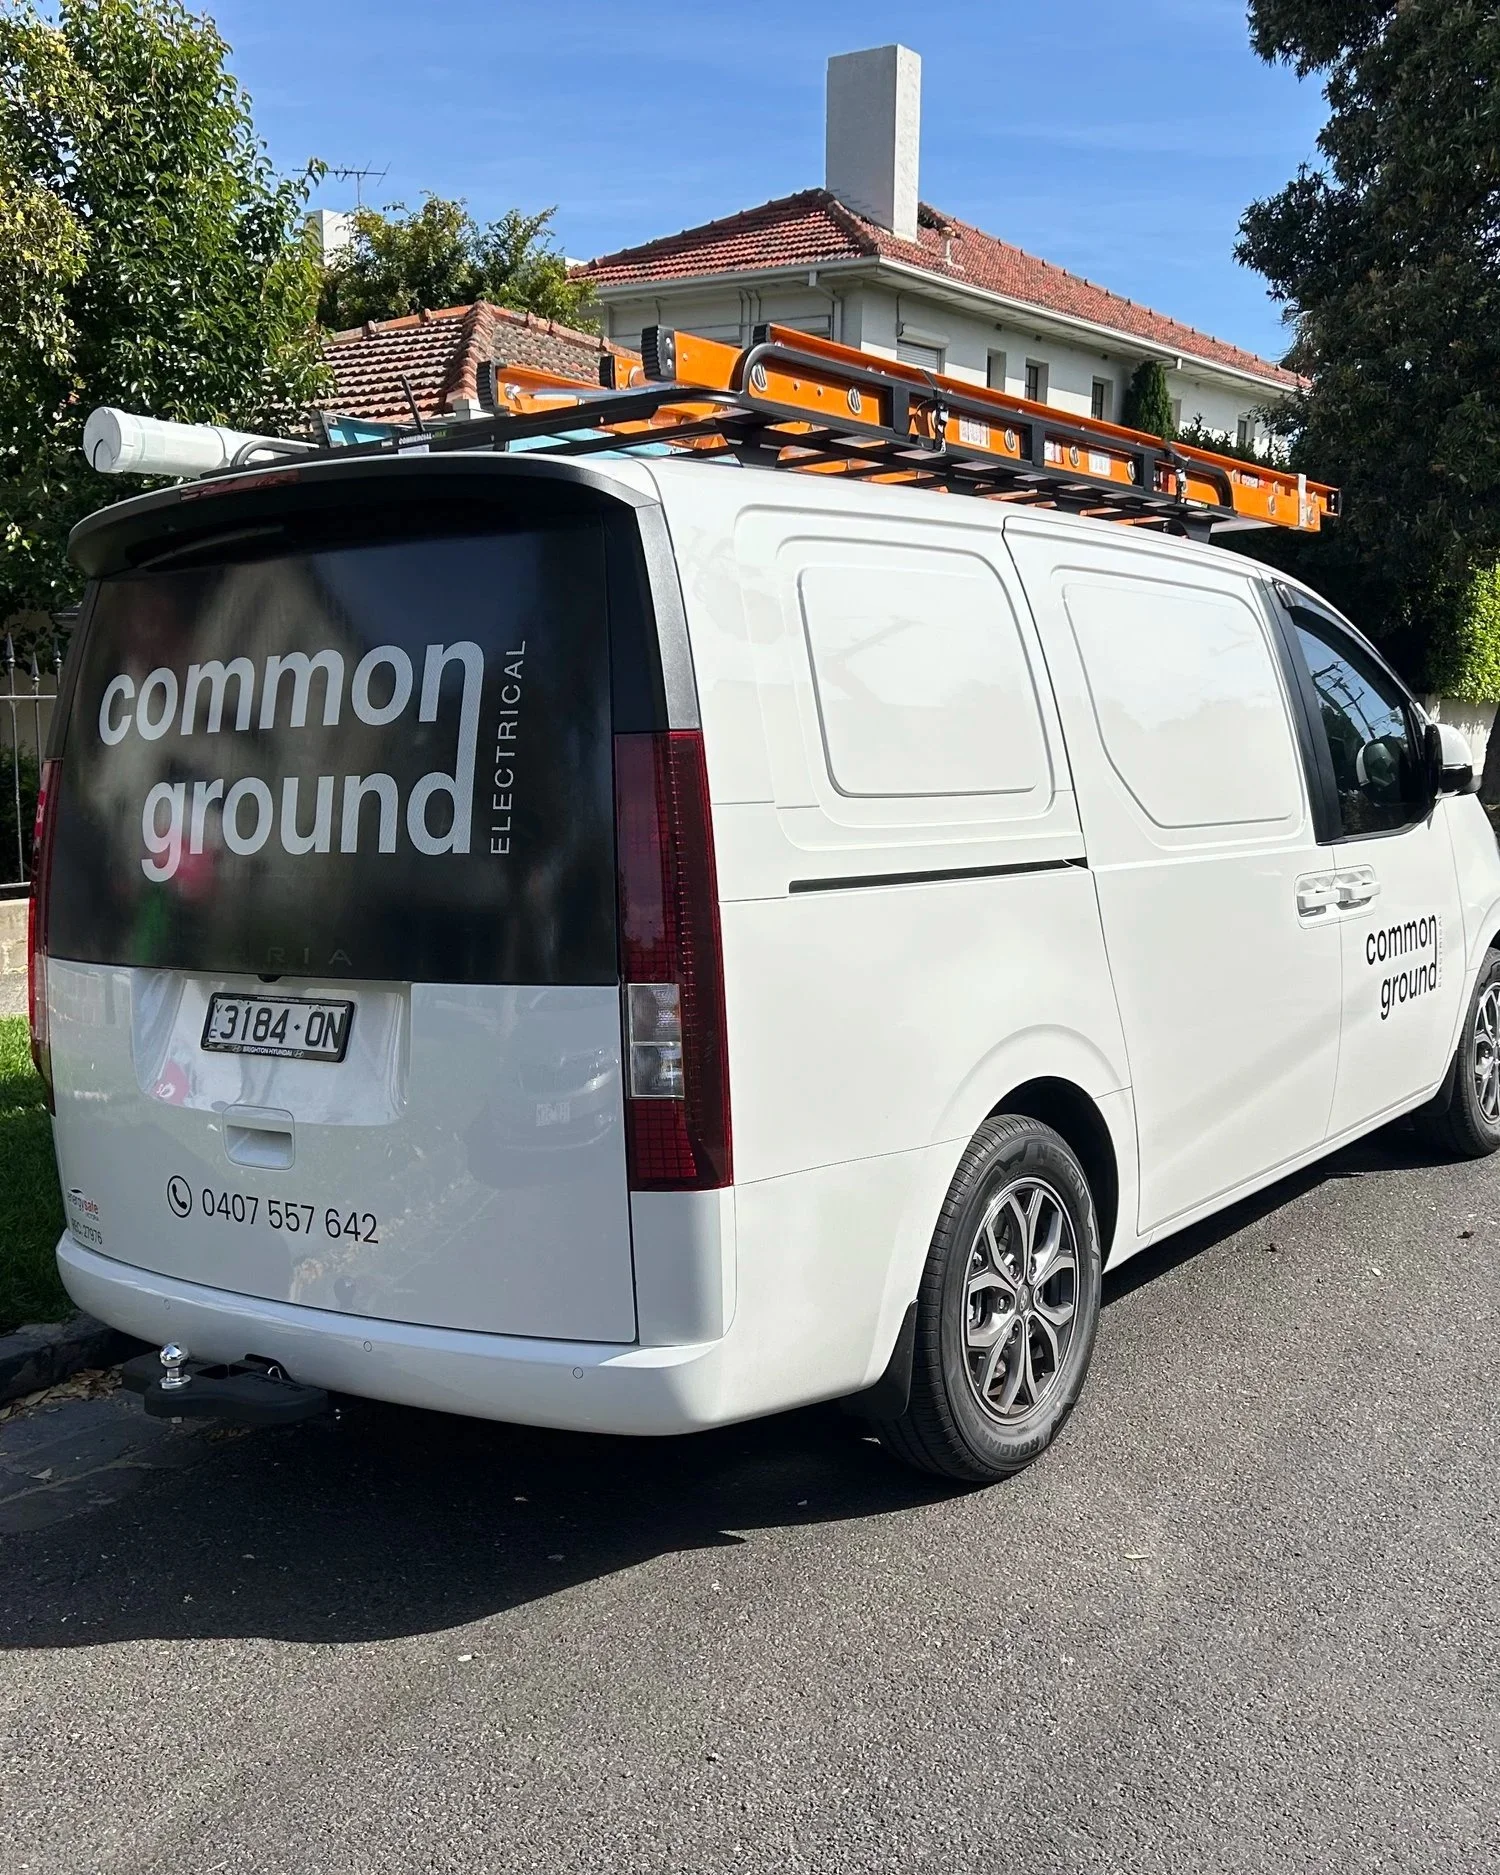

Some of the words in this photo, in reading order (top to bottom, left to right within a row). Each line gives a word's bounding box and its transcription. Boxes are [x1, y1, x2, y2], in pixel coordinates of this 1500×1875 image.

[98, 640, 485, 747] common
[490, 640, 526, 855] ELECTRICAL
[140, 762, 479, 883] ground
[1365, 914, 1437, 966] common
[1380, 962, 1437, 1021] ground
[268, 1047, 293, 1057] HYUNDAI
[202, 1188, 259, 1225] 0407
[268, 1199, 315, 1235] 557
[325, 1208, 379, 1245] 642
